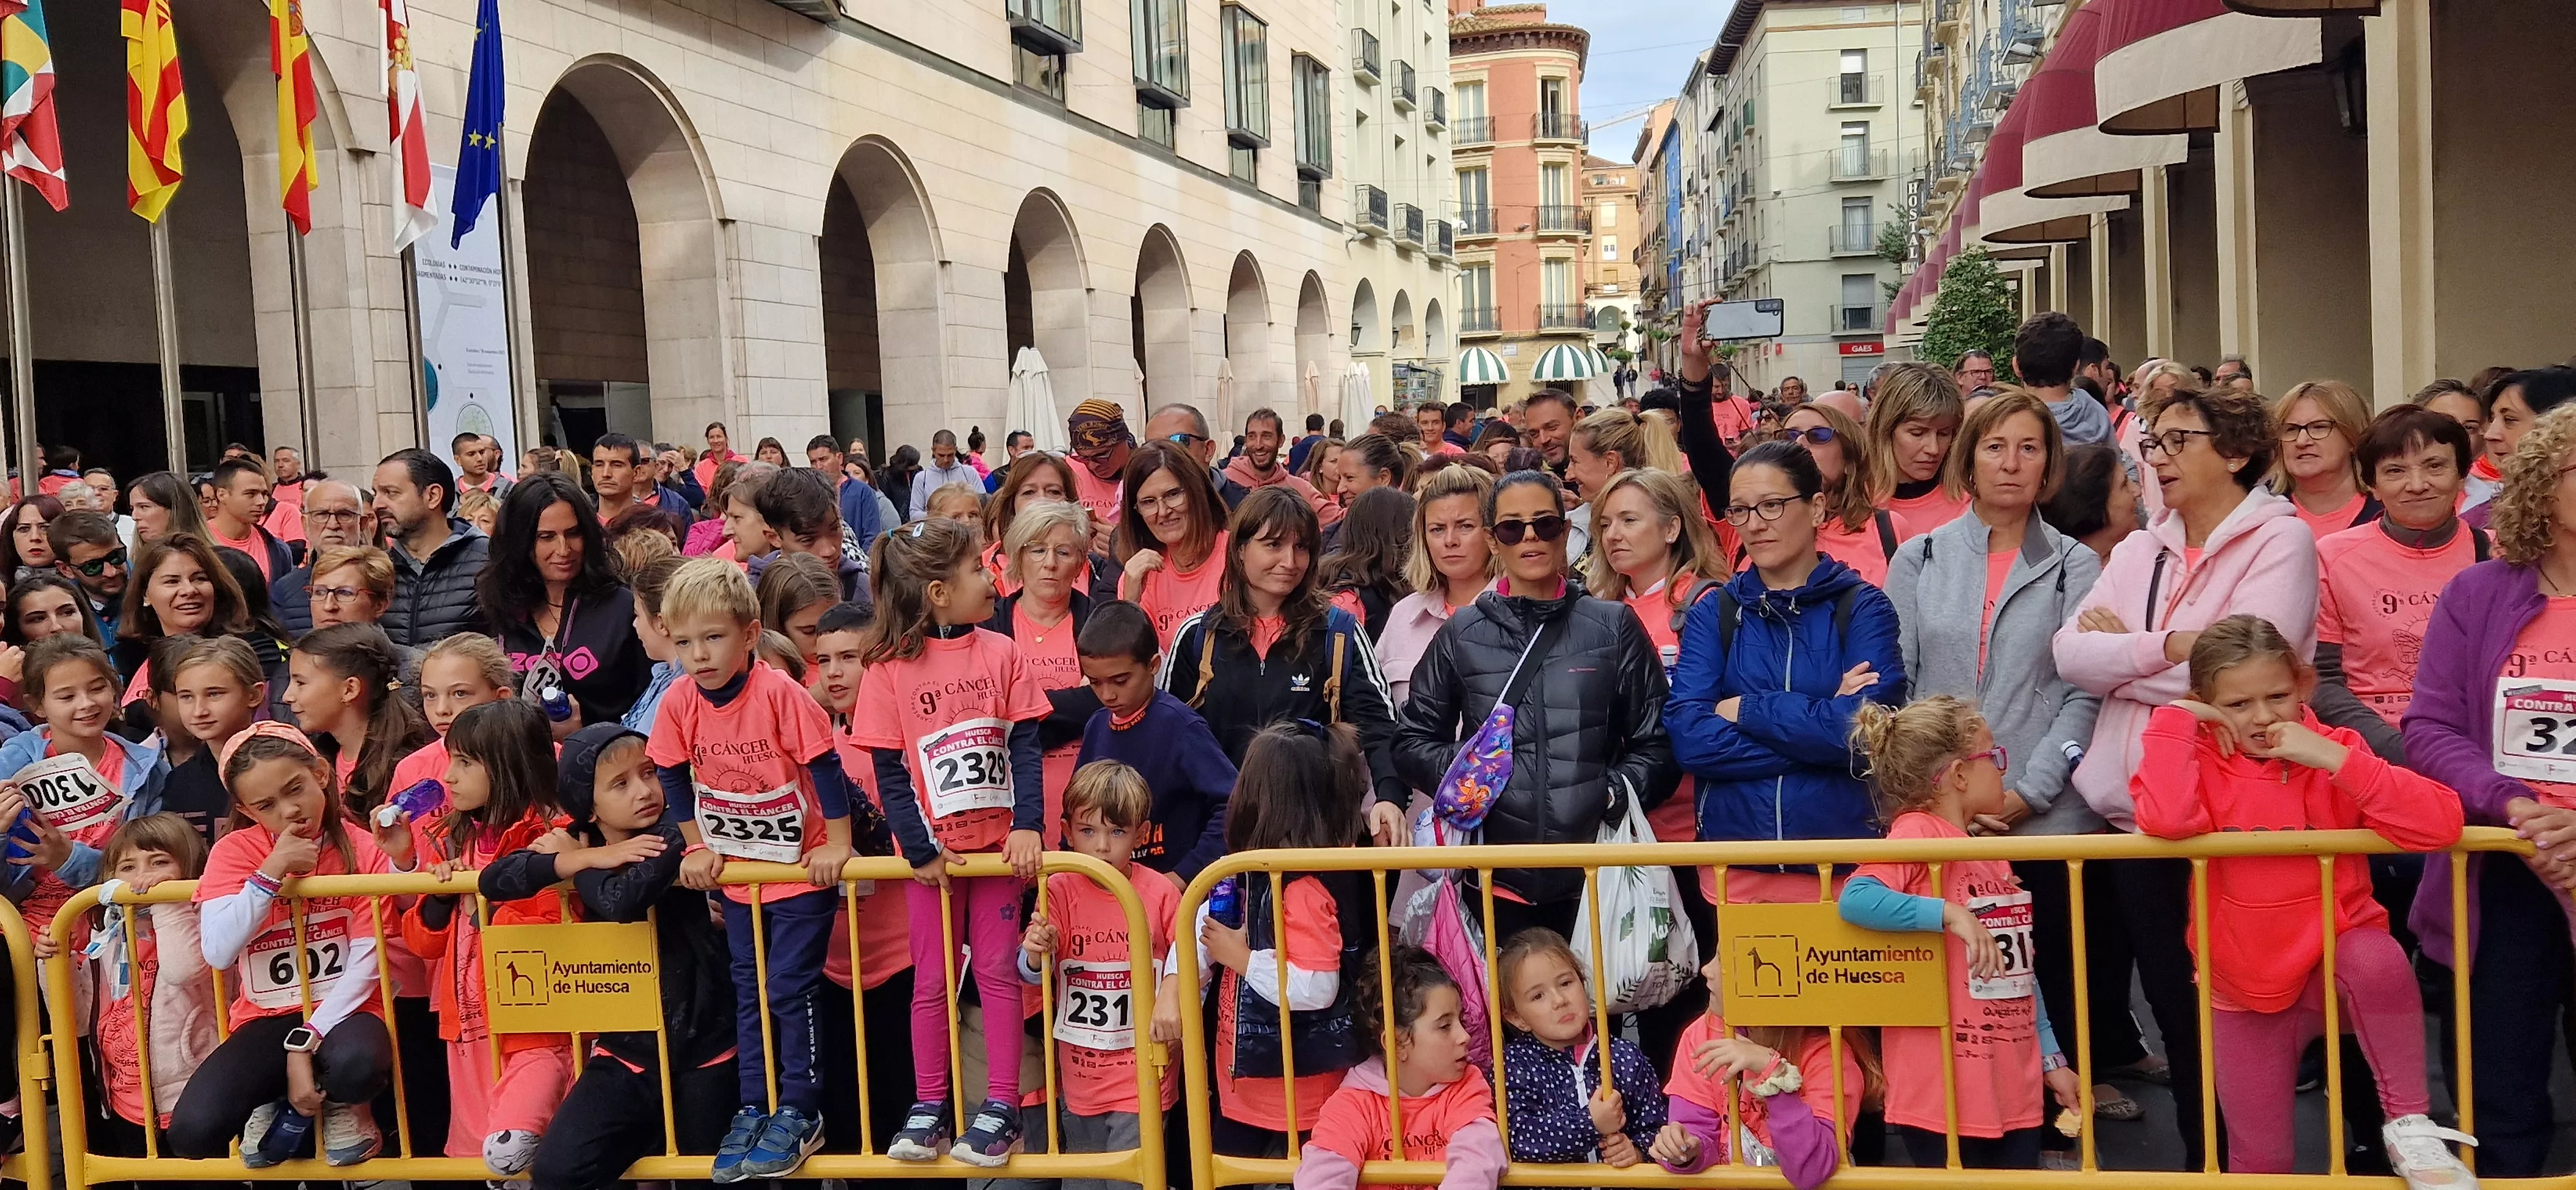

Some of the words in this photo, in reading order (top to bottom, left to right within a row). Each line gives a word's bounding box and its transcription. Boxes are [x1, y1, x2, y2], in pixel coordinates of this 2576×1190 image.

[1908, 181, 1919, 258] HOSTAL
[1851, 345, 1873, 354] GAES
[1032, 657, 1076, 666] CÁNCER
[920, 690, 942, 715] 9ª
[2515, 698, 2574, 713] CONTRA
[965, 728, 992, 737] HUESCA
[711, 739, 770, 755] CÁNCER
[933, 737, 976, 757] CONTRA
[977, 736, 988, 745] EL
[935, 751, 1006, 792] 2329
[21, 773, 98, 809] 1300
[75, 795, 110, 813] CONTRA
[702, 801, 739, 815] CONTRA
[753, 802, 795, 816] CÁNCER
[705, 814, 802, 843] 2325
[314, 926, 344, 940] CÁNCER
[1072, 934, 1092, 956] 9ª
[269, 943, 343, 985] 602
[1805, 945, 1935, 965] Ayuntamiento
[552, 959, 652, 977] Ayuntamiento
[1806, 968, 1830, 984] de
[1835, 968, 1905, 984] Huesca
[553, 979, 571, 994] de
[576, 980, 630, 994] Huesca
[1071, 978, 1104, 989] CONTRA
[1106, 980, 1117, 989] EL
[1068, 991, 1128, 1026] 231
